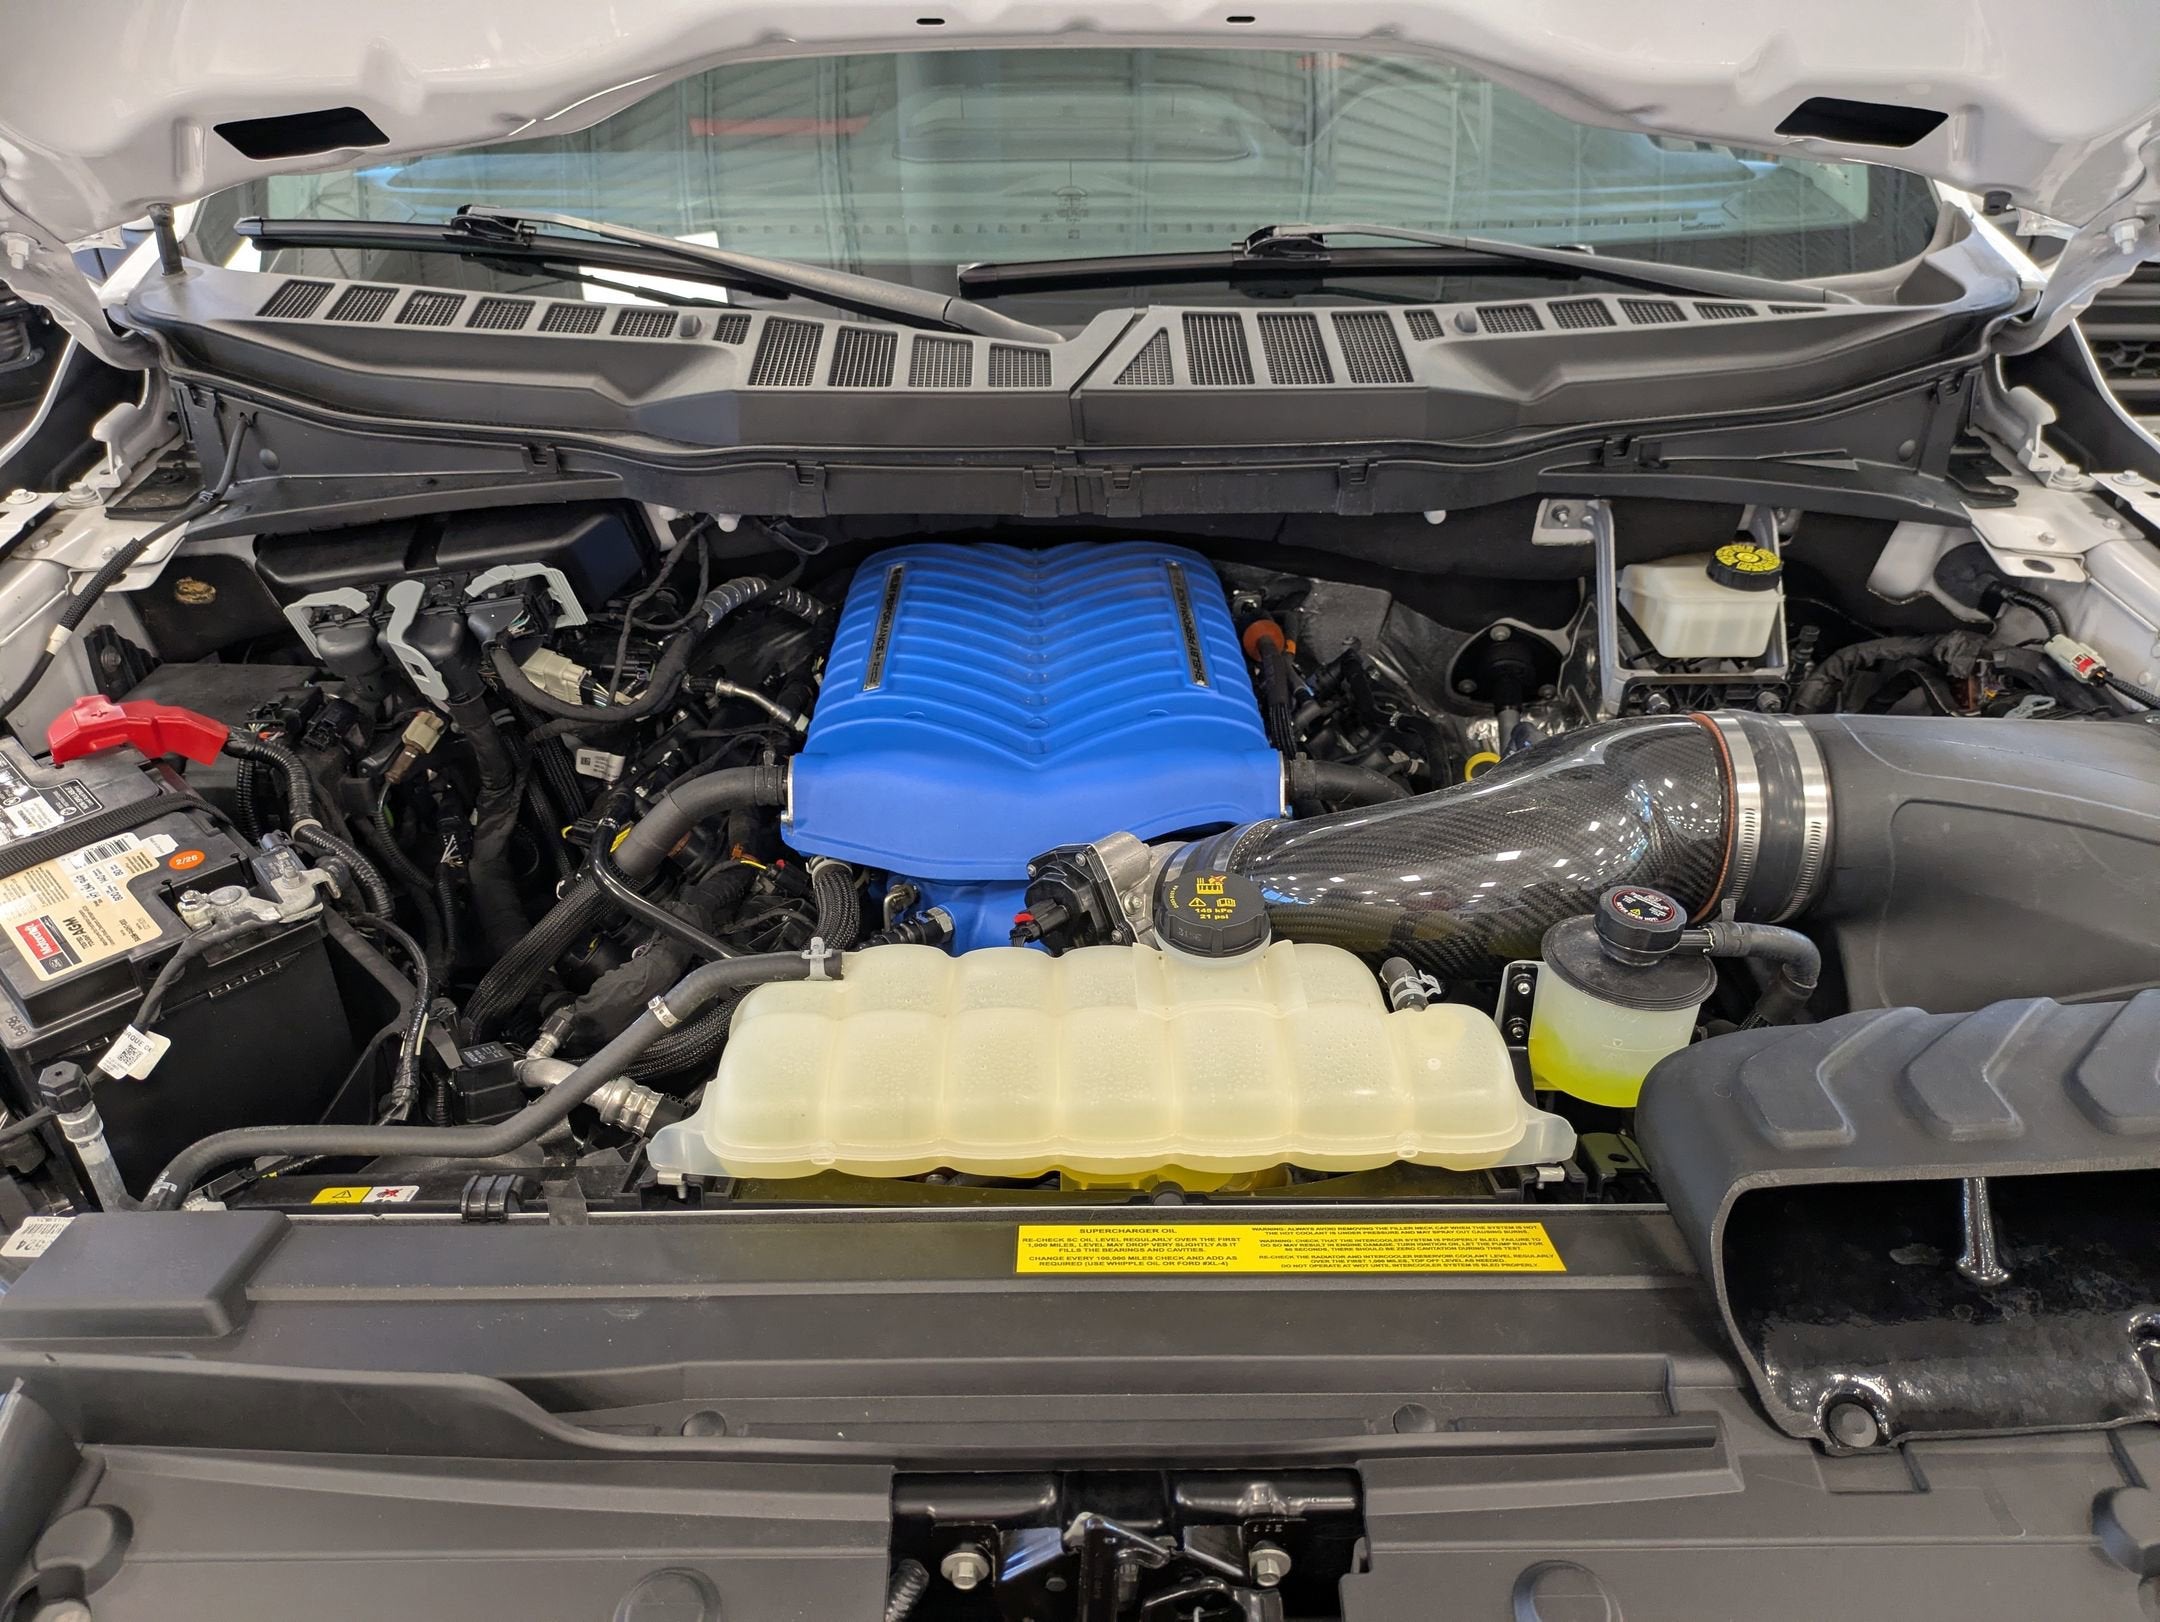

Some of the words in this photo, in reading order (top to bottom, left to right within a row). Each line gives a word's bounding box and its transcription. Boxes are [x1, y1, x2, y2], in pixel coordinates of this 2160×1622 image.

[1188, 646, 1205, 681] SHELBY
[176, 854, 198, 865] 2/26
[23, 923, 54, 955] Motorcraft
[61, 915, 86, 937] AGM
